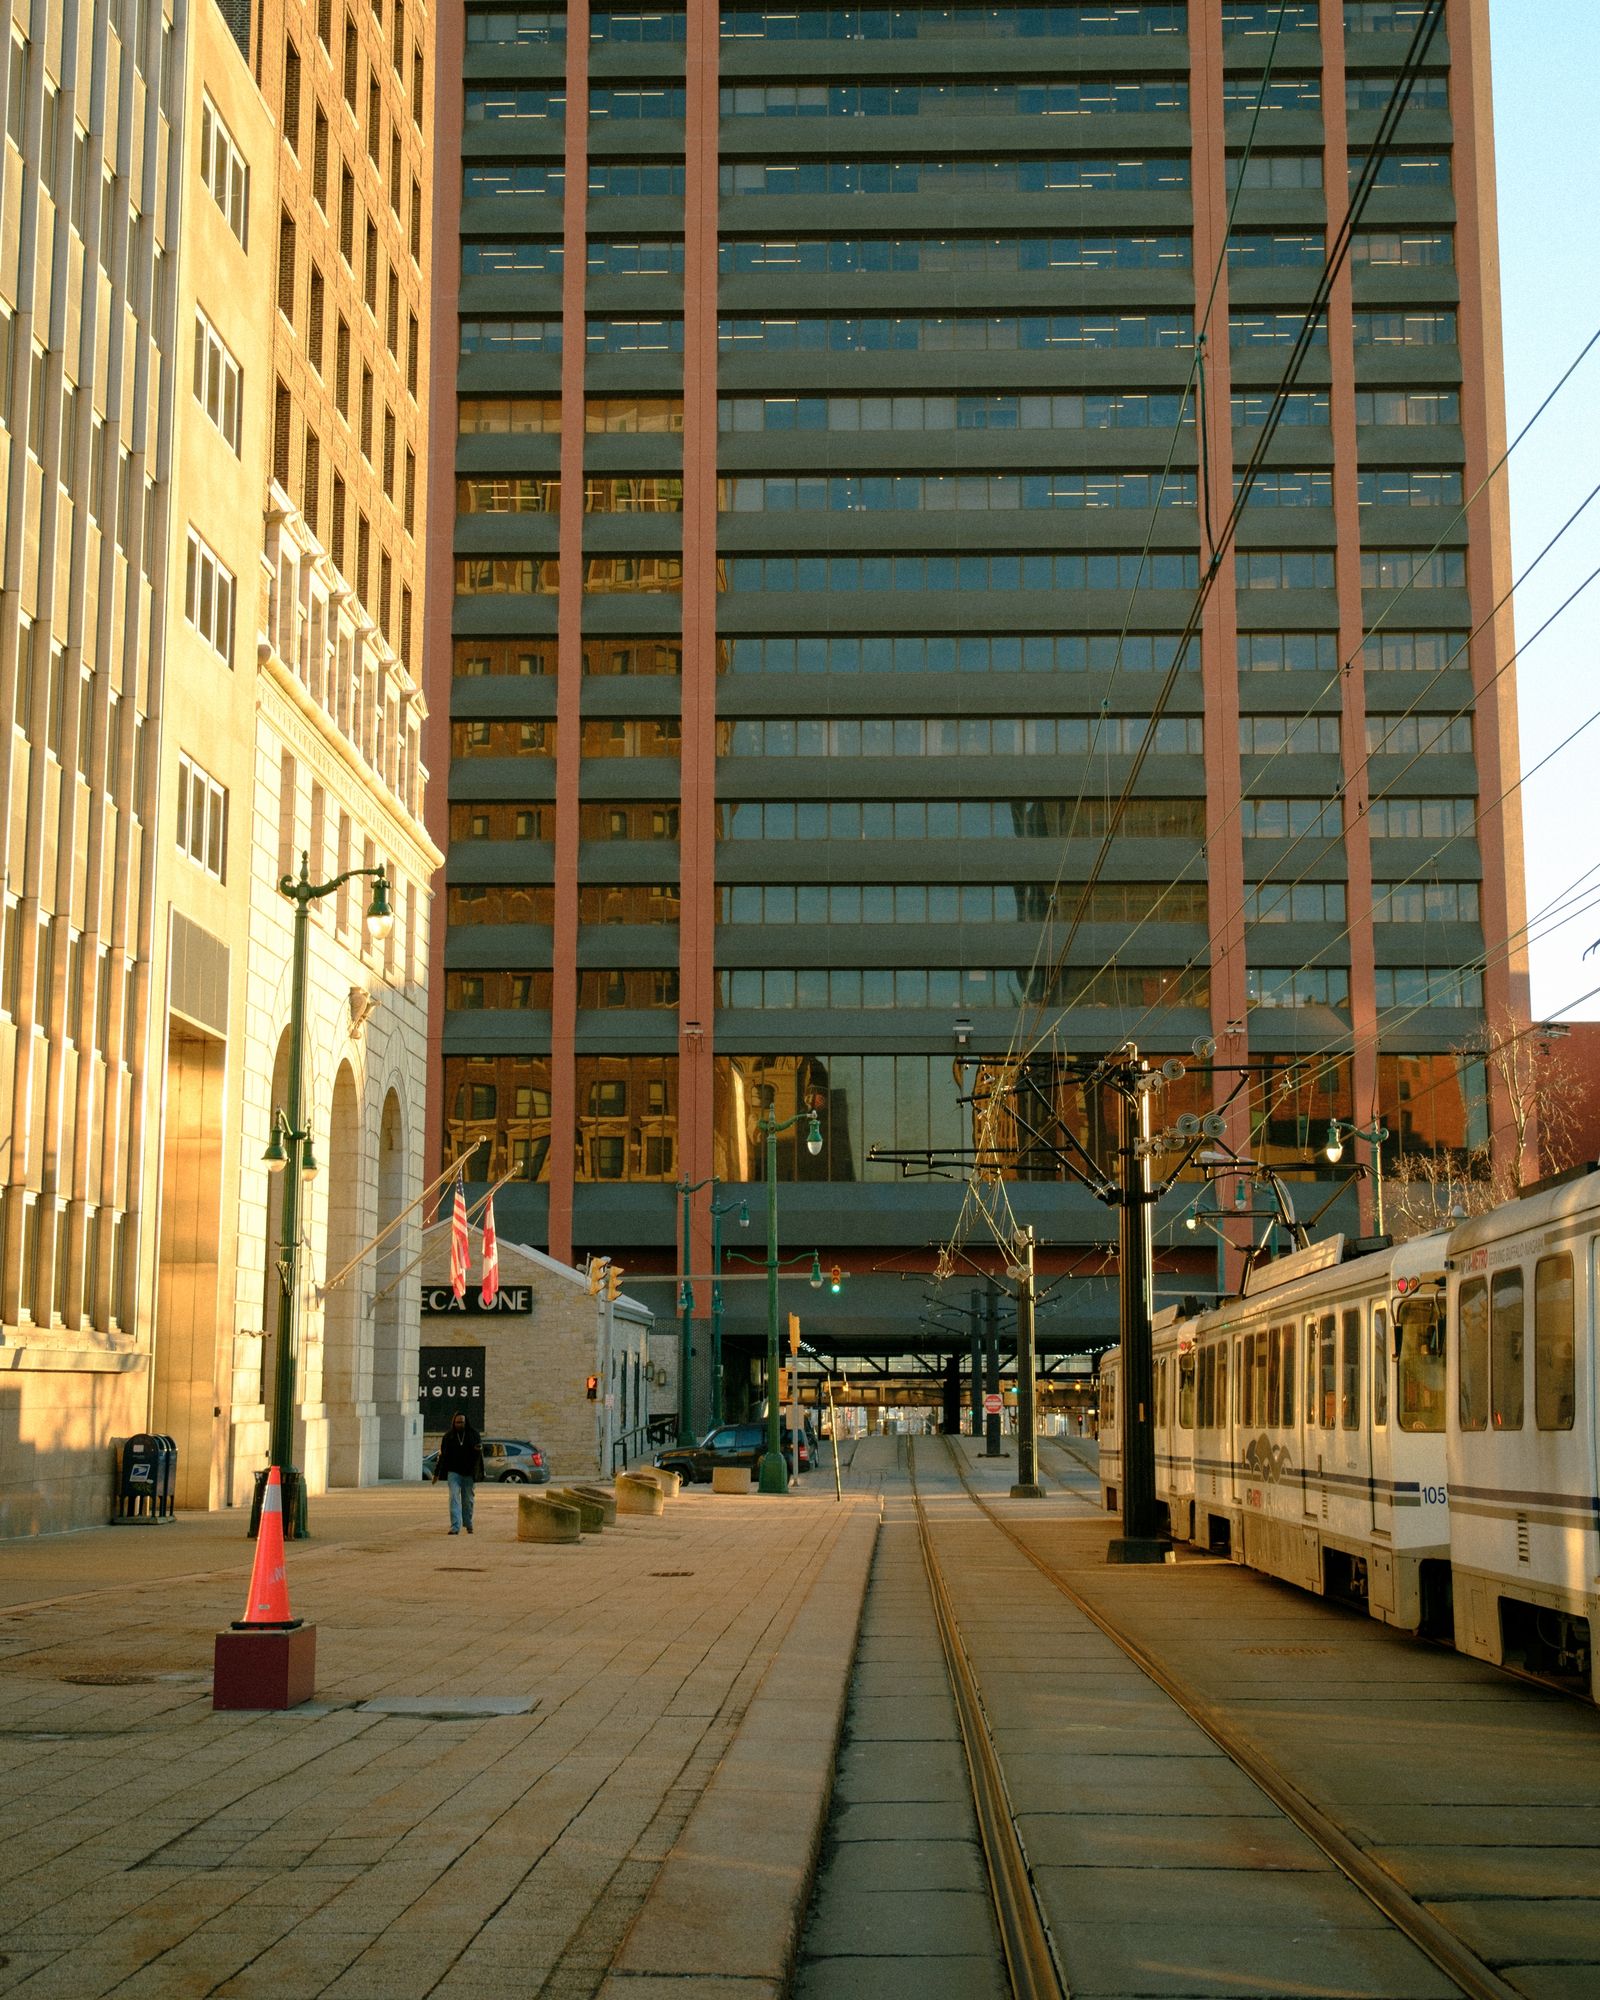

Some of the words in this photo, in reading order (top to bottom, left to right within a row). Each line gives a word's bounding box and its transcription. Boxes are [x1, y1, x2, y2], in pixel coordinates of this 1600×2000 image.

[478, 1290, 528, 1310] ONE
[427, 1366, 473, 1378] CLUB
[419, 1386, 480, 1397] HOUSE
[1422, 1486, 1446, 1504] 105
